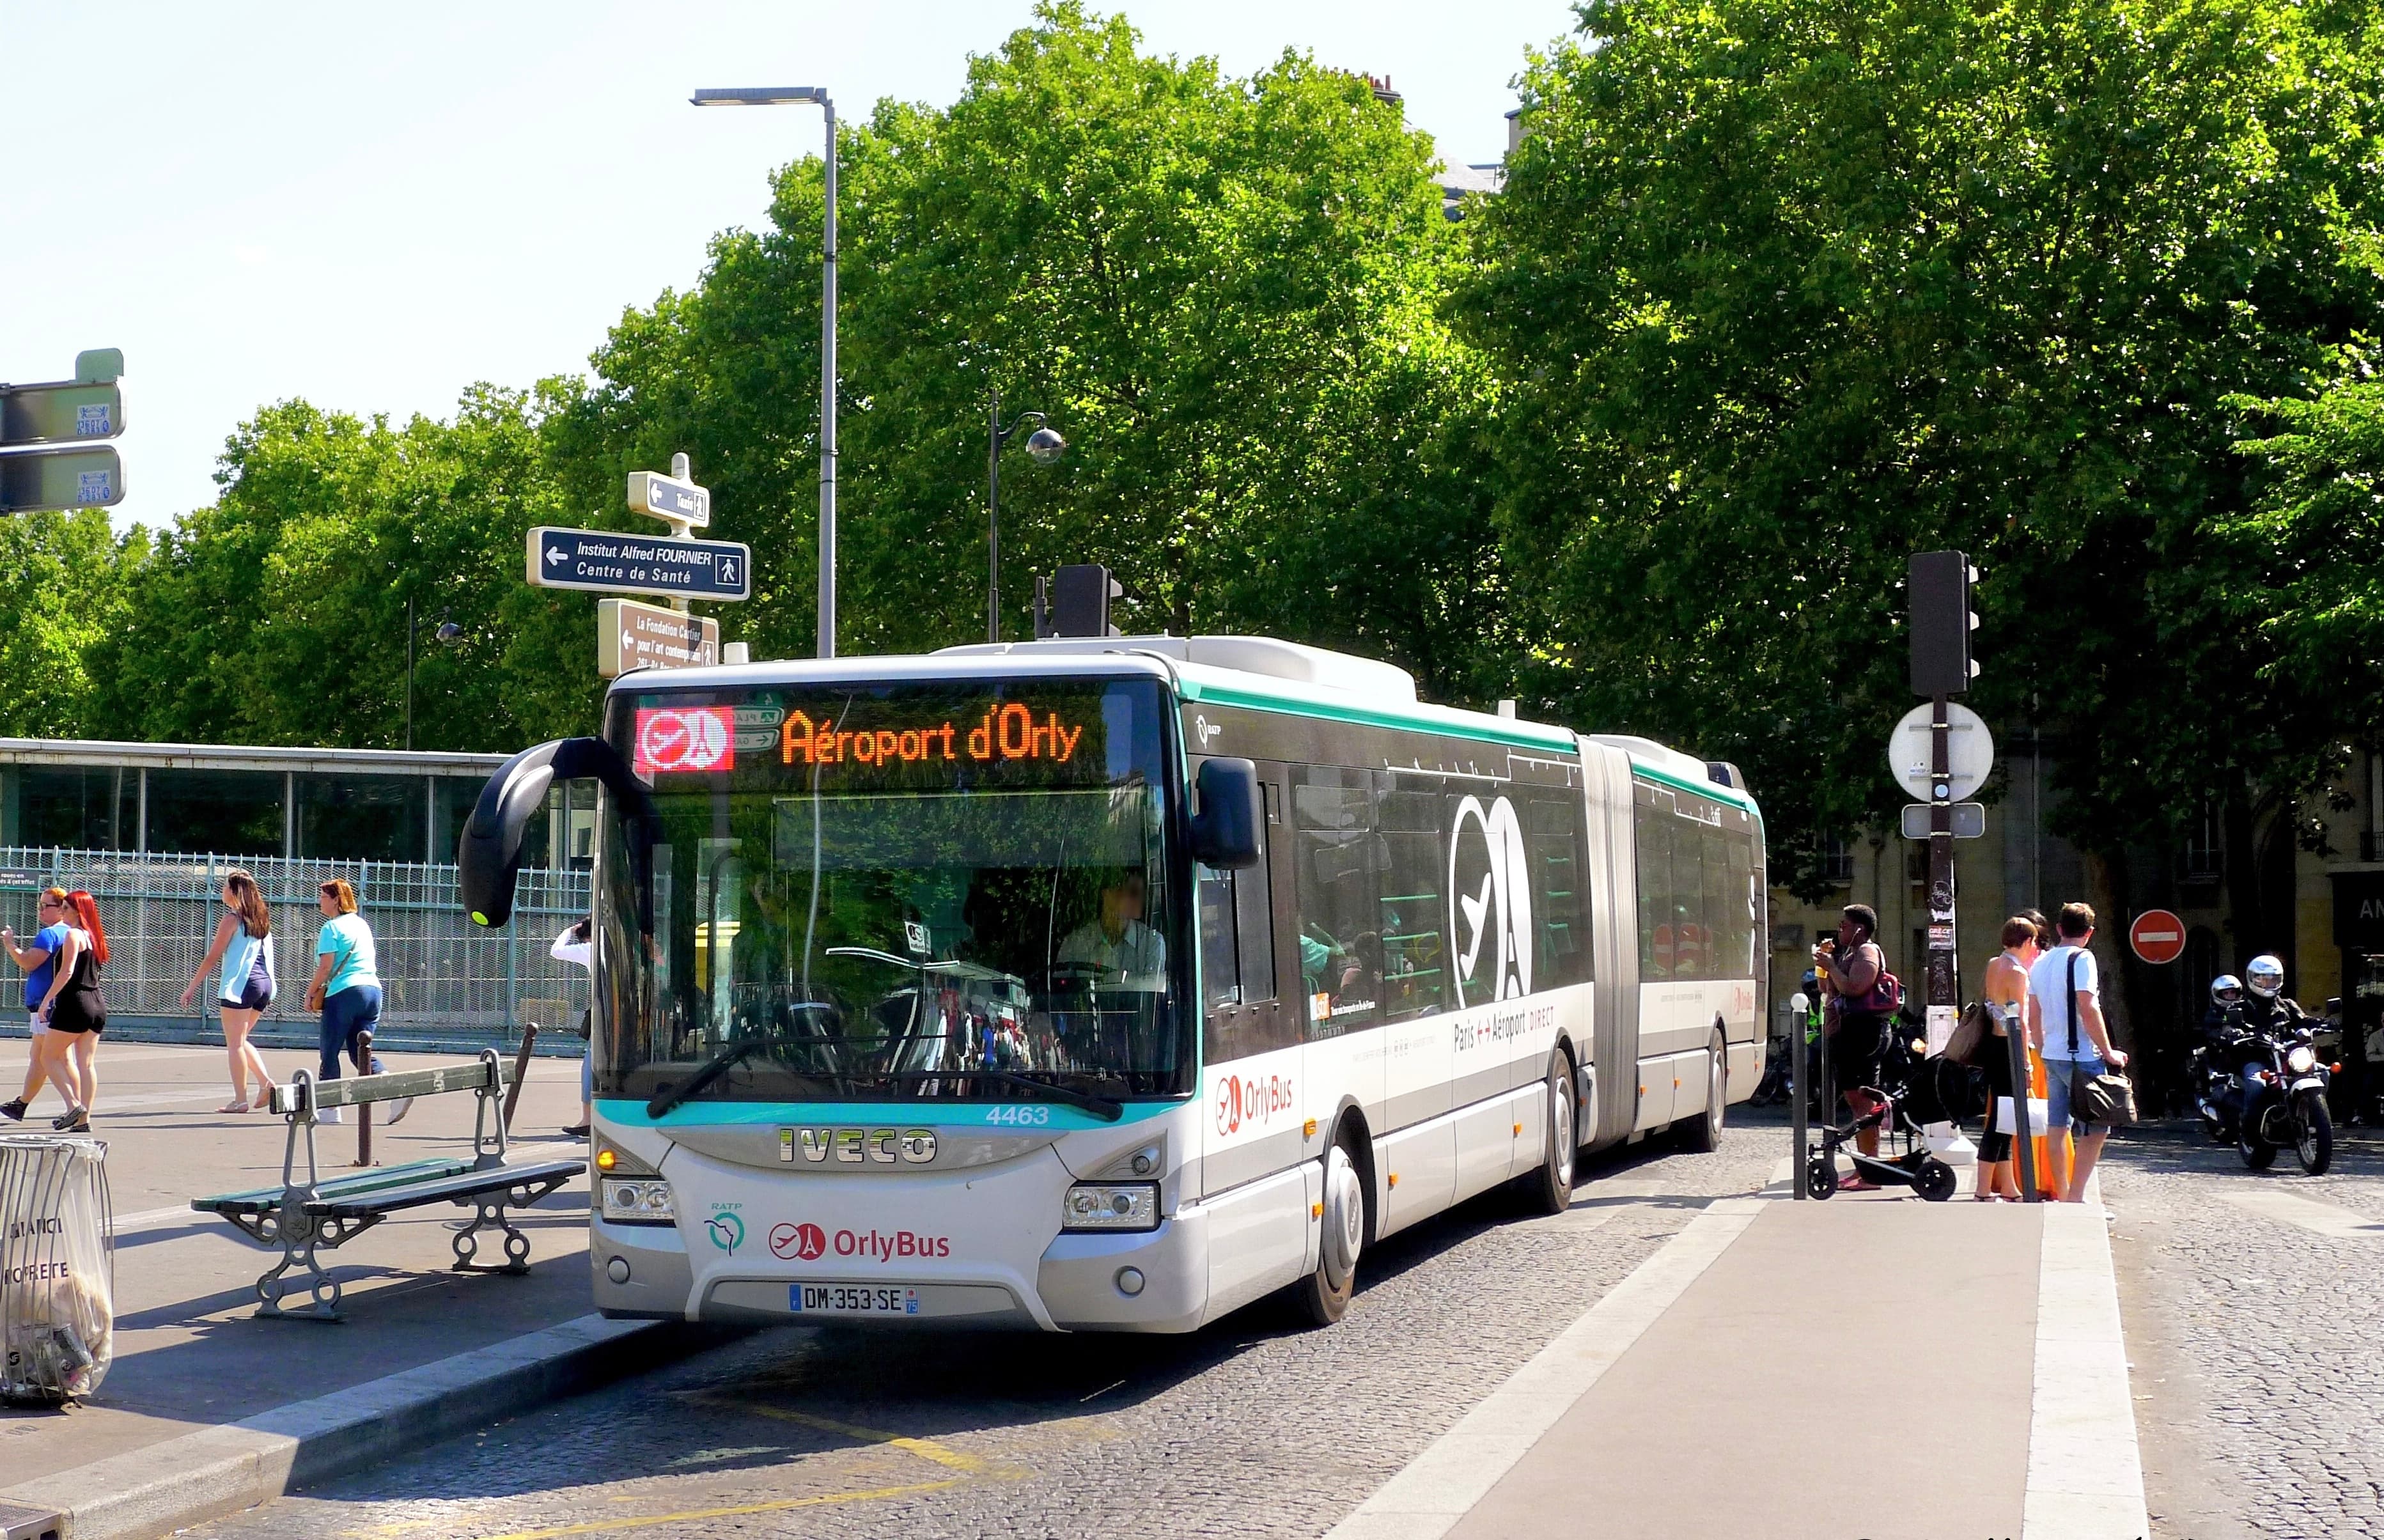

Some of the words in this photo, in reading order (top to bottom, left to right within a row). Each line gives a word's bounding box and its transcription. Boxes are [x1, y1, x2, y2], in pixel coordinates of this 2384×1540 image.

[577, 541, 618, 557] Institut
[620, 545, 655, 561] Alfred
[655, 548, 712, 565] FOURNIER
[577, 562, 623, 579] Centre
[630, 566, 646, 580] de
[651, 568, 691, 583] Santé
[637, 616, 644, 630] La
[646, 618, 678, 637] Fondation
[679, 625, 701, 642] Cartier
[637, 640, 651, 653] pour
[783, 710, 955, 766] Aéroport
[969, 703, 1082, 762] d'Orly
[1207, 724, 1221, 735] RATP
[1454, 1018, 1474, 1053] Paris
[1492, 1008, 1525, 1045] Aéroport
[1530, 1006, 1554, 1031] DIRECT
[1245, 1075, 1291, 1125] OrlyBus
[986, 1106, 1049, 1124] 4463
[779, 1129, 938, 1163] IVECO
[834, 1229, 950, 1263] OrlyBus
[804, 1288, 901, 1311] DM-353-SE
[907, 1301, 917, 1310] 75
